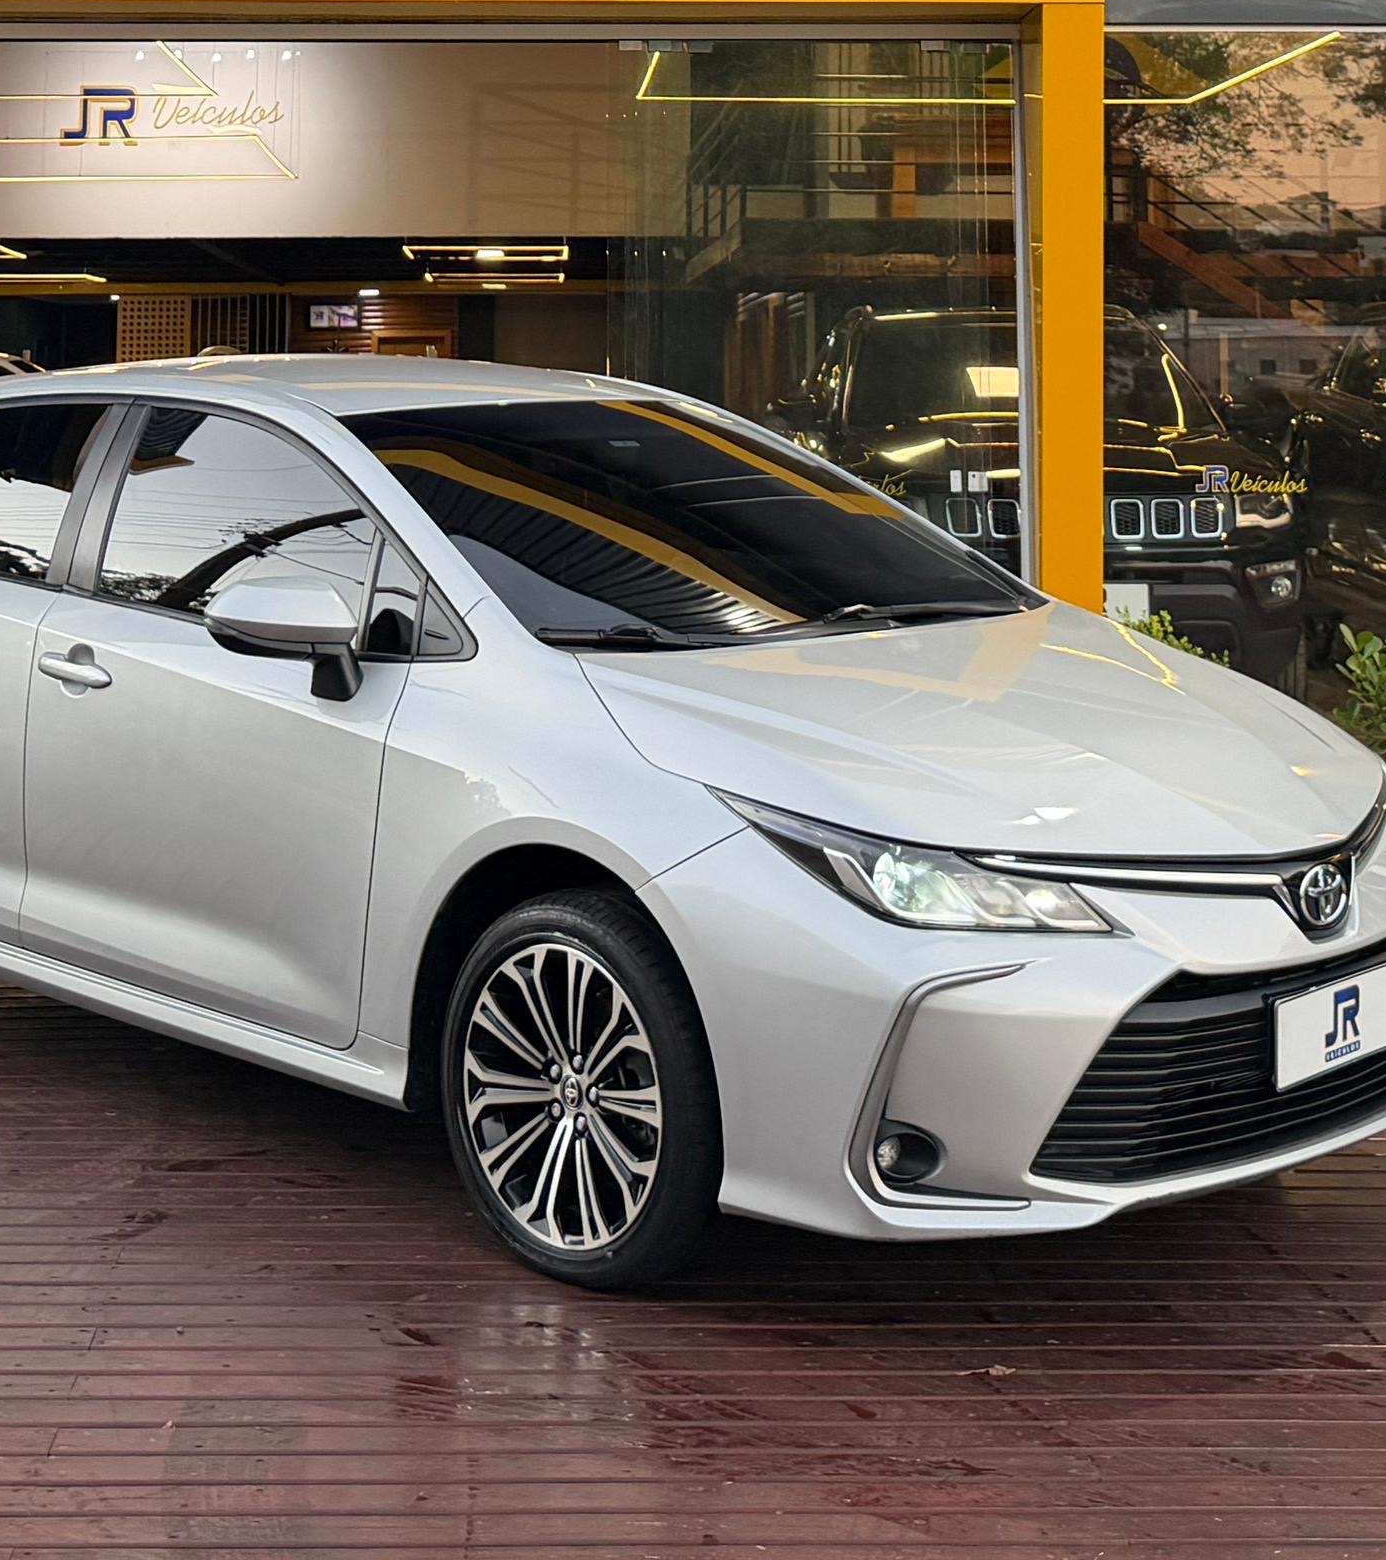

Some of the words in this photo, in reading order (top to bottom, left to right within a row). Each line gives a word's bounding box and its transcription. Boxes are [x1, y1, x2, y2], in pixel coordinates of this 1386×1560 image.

[60, 85, 138, 147] JR
[1195, 465, 1230, 493] JR
[1230, 470, 1308, 493] Veículos
[1324, 984, 1360, 1049] JR
